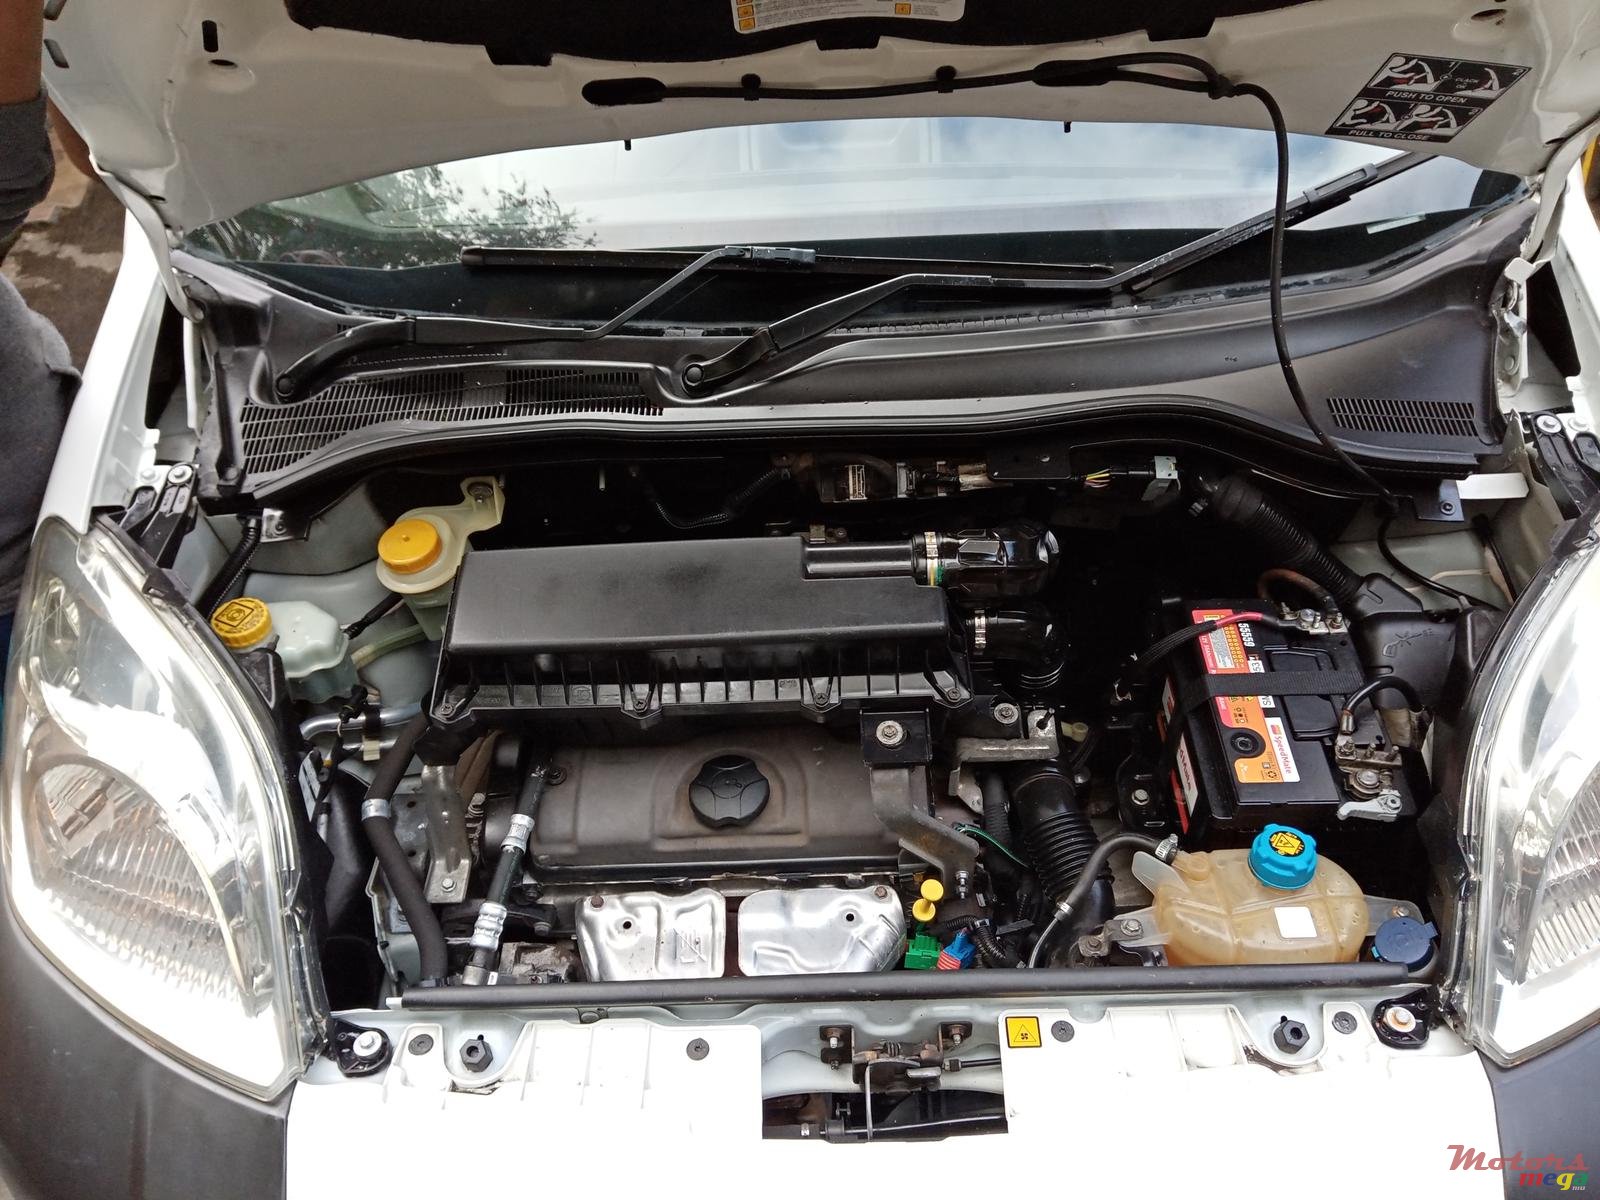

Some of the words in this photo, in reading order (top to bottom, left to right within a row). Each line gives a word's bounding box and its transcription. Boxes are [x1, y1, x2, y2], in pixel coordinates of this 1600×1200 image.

[1385, 90, 1418, 99] PUSH
[1436, 94, 1468, 104] OPEN
[1348, 129, 1375, 138] PULL
[1393, 132, 1431, 141] CLOSE
[1275, 735, 1293, 775] SpeedMate
